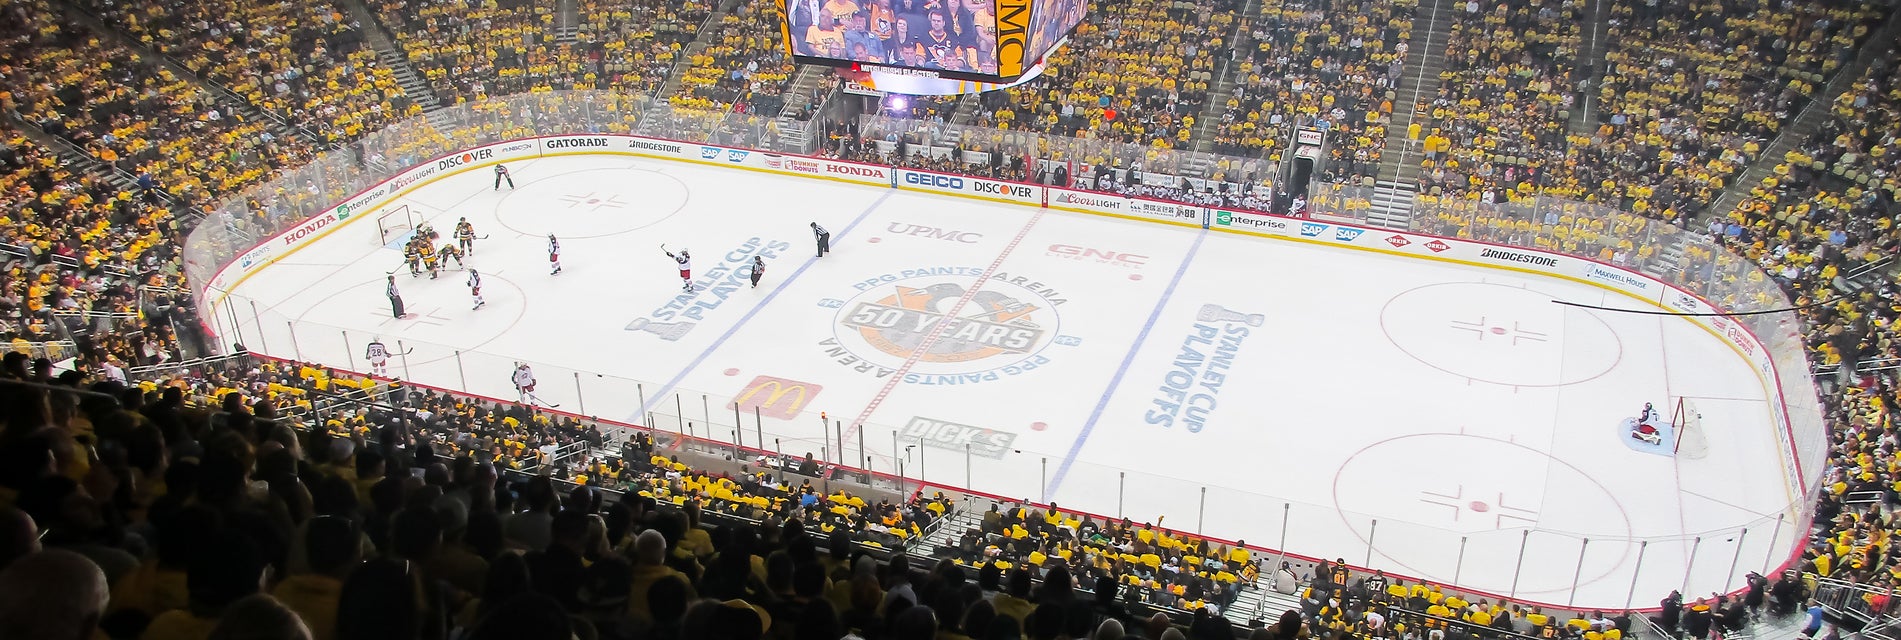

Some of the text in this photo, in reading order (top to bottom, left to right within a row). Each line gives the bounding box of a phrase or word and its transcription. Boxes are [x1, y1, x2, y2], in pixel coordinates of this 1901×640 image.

[860, 64, 939, 78] MITSUBISHI ELECTRIC
[546, 138, 608, 149] GATORADE
[629, 140, 682, 153] BRIDGESTONE
[439, 149, 493, 171] DISCOVER
[702, 148, 718, 158] SAP
[729, 152, 746, 161] SAP
[416, 167, 435, 180] LIGHT
[826, 164, 885, 178] HONDA
[905, 172, 964, 189] GEICO
[974, 181, 1032, 198] DISCOVER
[338, 188, 385, 219] enterprise
[1067, 193, 1121, 210] Coors LIGHT
[284, 214, 336, 245] HONDA
[1217, 212, 1286, 229] enterprise
[1301, 224, 1322, 235] SAP
[886, 221, 983, 244] UPMC
[1336, 229, 1358, 240] SAP
[1048, 243, 1149, 265] GNC
[1480, 248, 1558, 267] BRIDGESTONE
[652, 236, 763, 321] STANLEY CUP
[853, 266, 1069, 308] PPG PAINTS ARENA
[1594, 268, 1625, 283] MAXWELL
[1626, 277, 1647, 289] HOUSE
[851, 305, 1032, 352] 50 YEARS
[372, 348, 382, 357] 28
[1734, 337, 1753, 356] DONUTS
[818, 337, 1052, 386] PPG PAINTS ARENA
[1144, 323, 1219, 428] PLAYOFFS
[1182, 323, 1250, 434] STANLEY CUP
